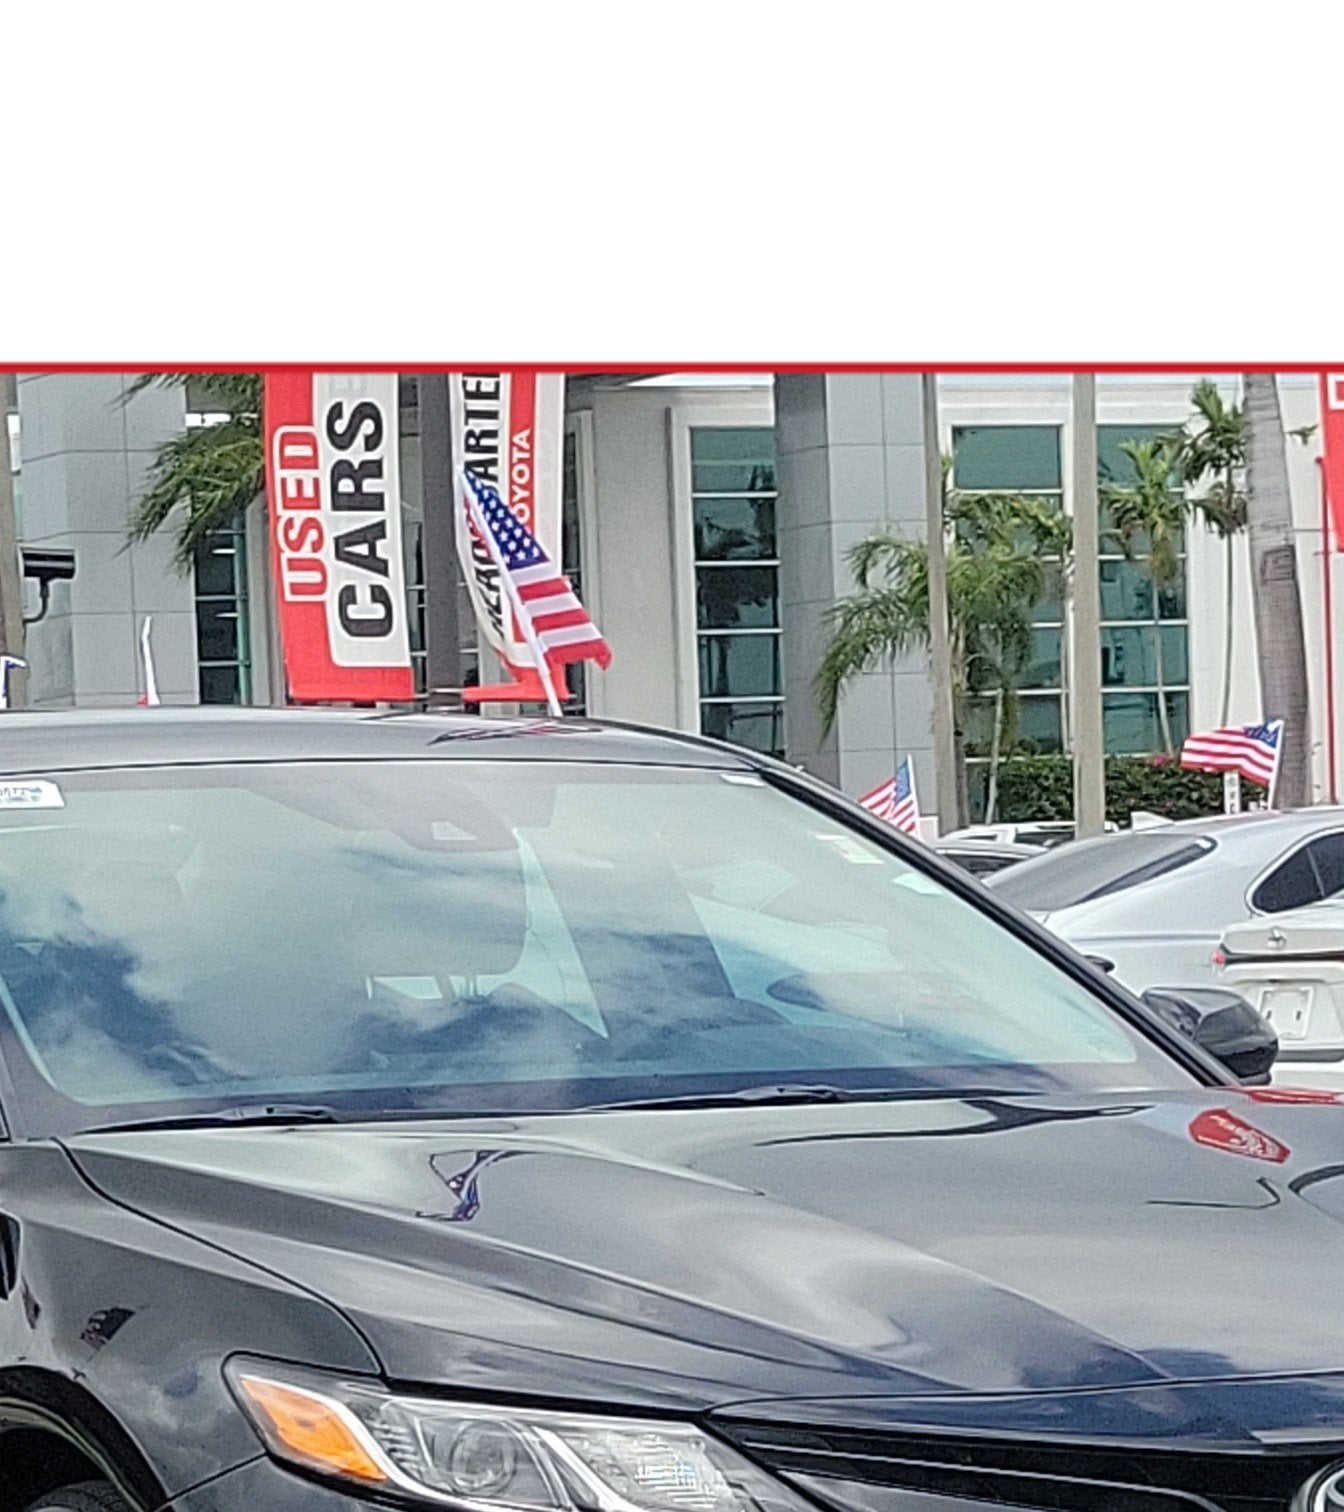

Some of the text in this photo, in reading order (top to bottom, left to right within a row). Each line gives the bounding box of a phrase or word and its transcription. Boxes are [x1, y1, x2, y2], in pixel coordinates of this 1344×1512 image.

[278, 429, 327, 598] USED
[326, 401, 394, 638] CARS
[512, 429, 532, 527] OYOTA
